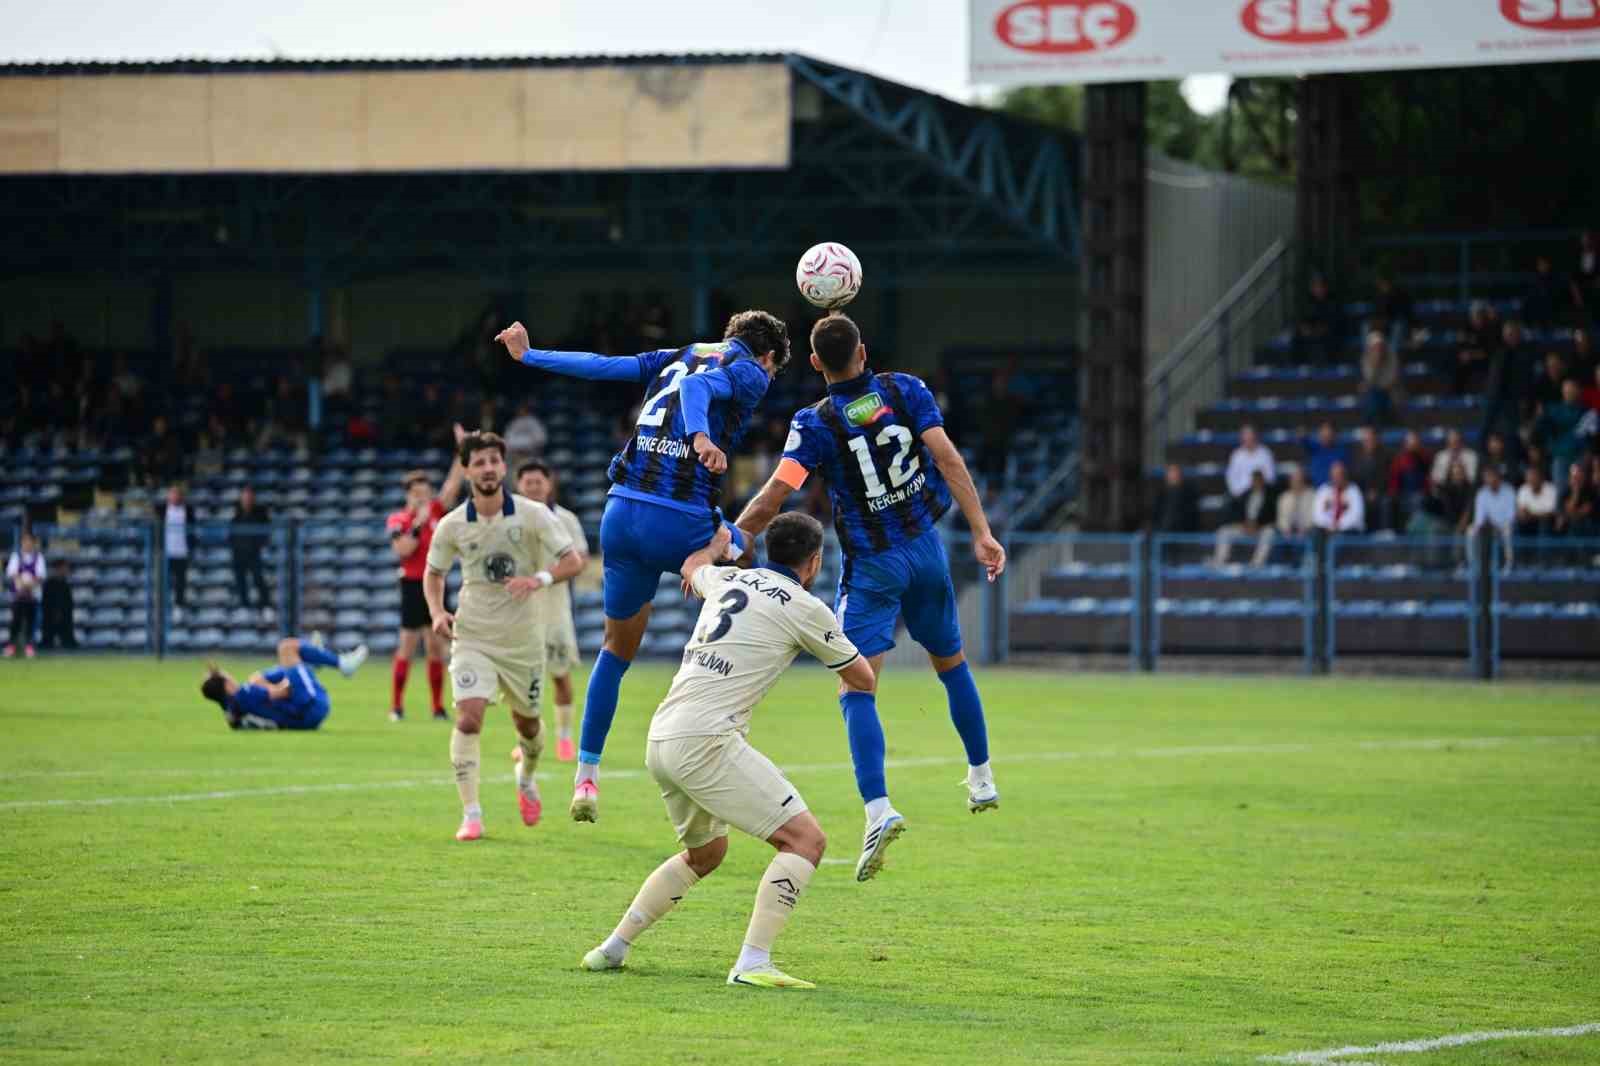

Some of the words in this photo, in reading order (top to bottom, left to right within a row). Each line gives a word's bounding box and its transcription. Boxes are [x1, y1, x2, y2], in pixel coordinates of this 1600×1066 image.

[1010, 4, 1118, 51] SEÇ
[1256, 0, 1373, 41] SEÇ
[656, 436, 690, 459] ÖZGÜN
[848, 424, 920, 499] 12
[867, 489, 906, 513] KEREM
[697, 588, 749, 643] 3
[528, 678, 541, 701] 5
